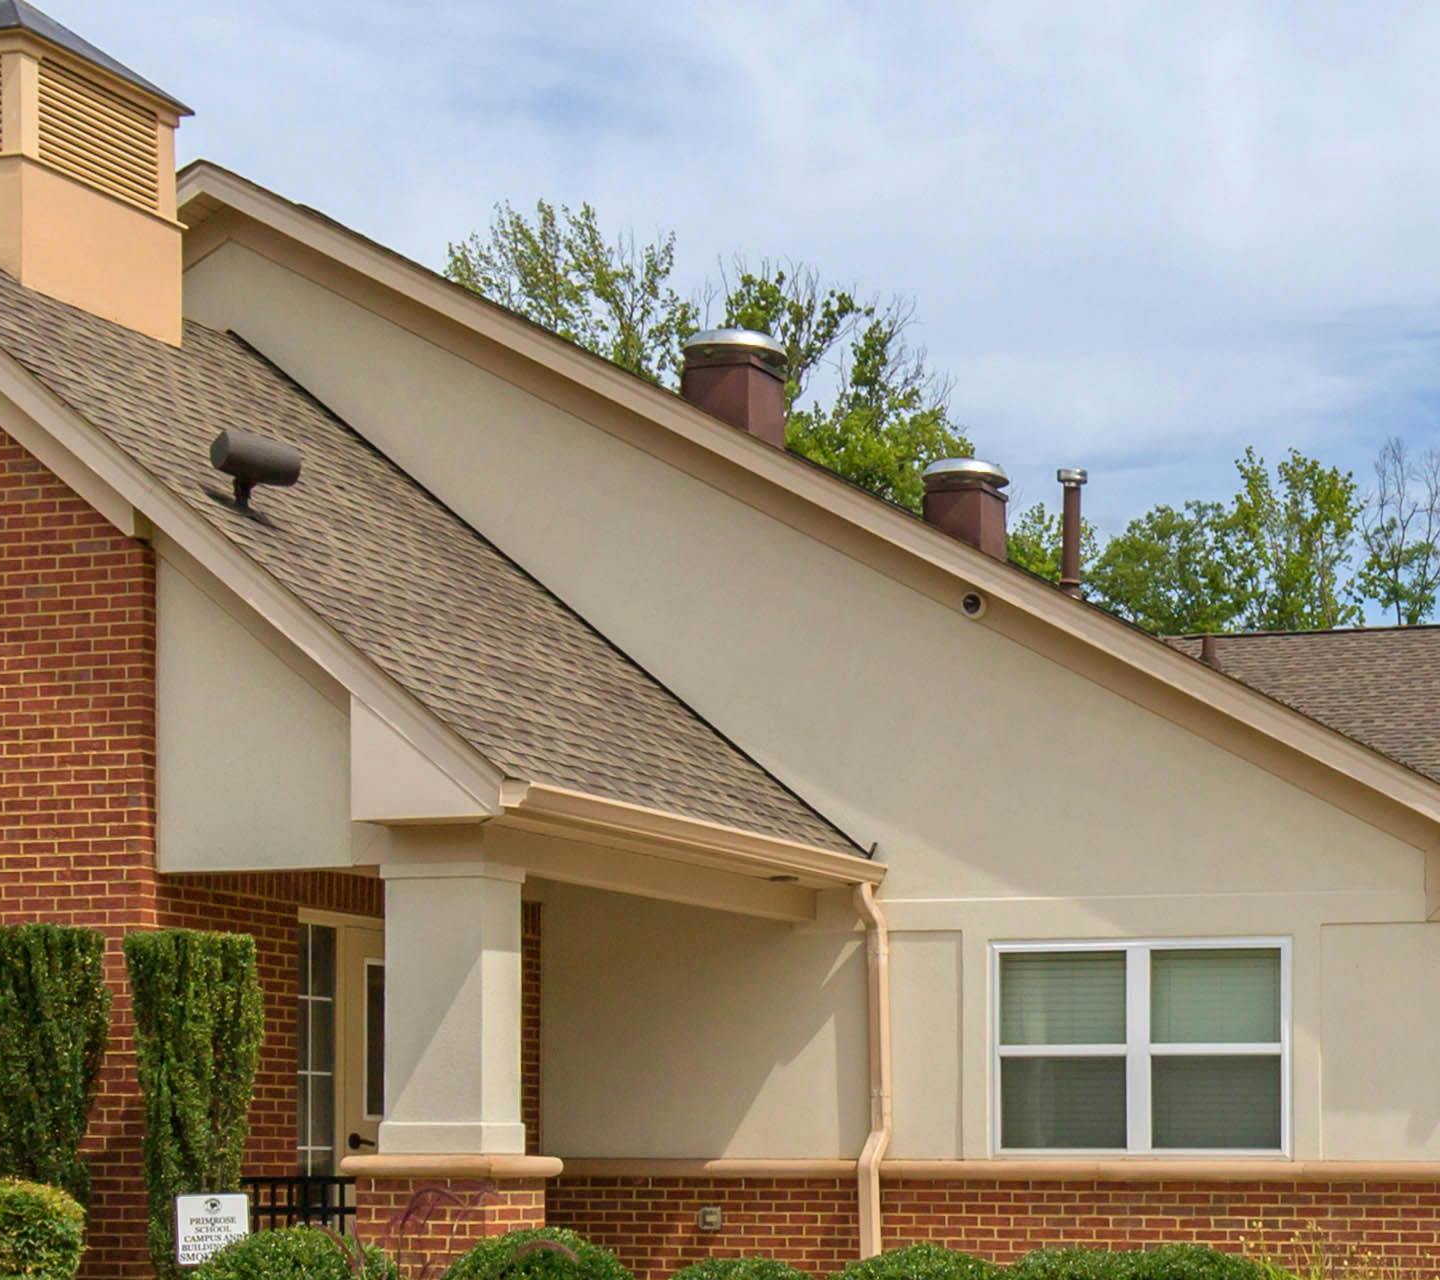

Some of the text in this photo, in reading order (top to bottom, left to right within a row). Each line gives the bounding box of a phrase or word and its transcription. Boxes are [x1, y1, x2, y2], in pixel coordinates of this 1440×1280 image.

[189, 1216, 237, 1226] PRIMROSE
[194, 1225, 232, 1233] SCHOOL
[183, 1234, 222, 1243] CAMPUS
